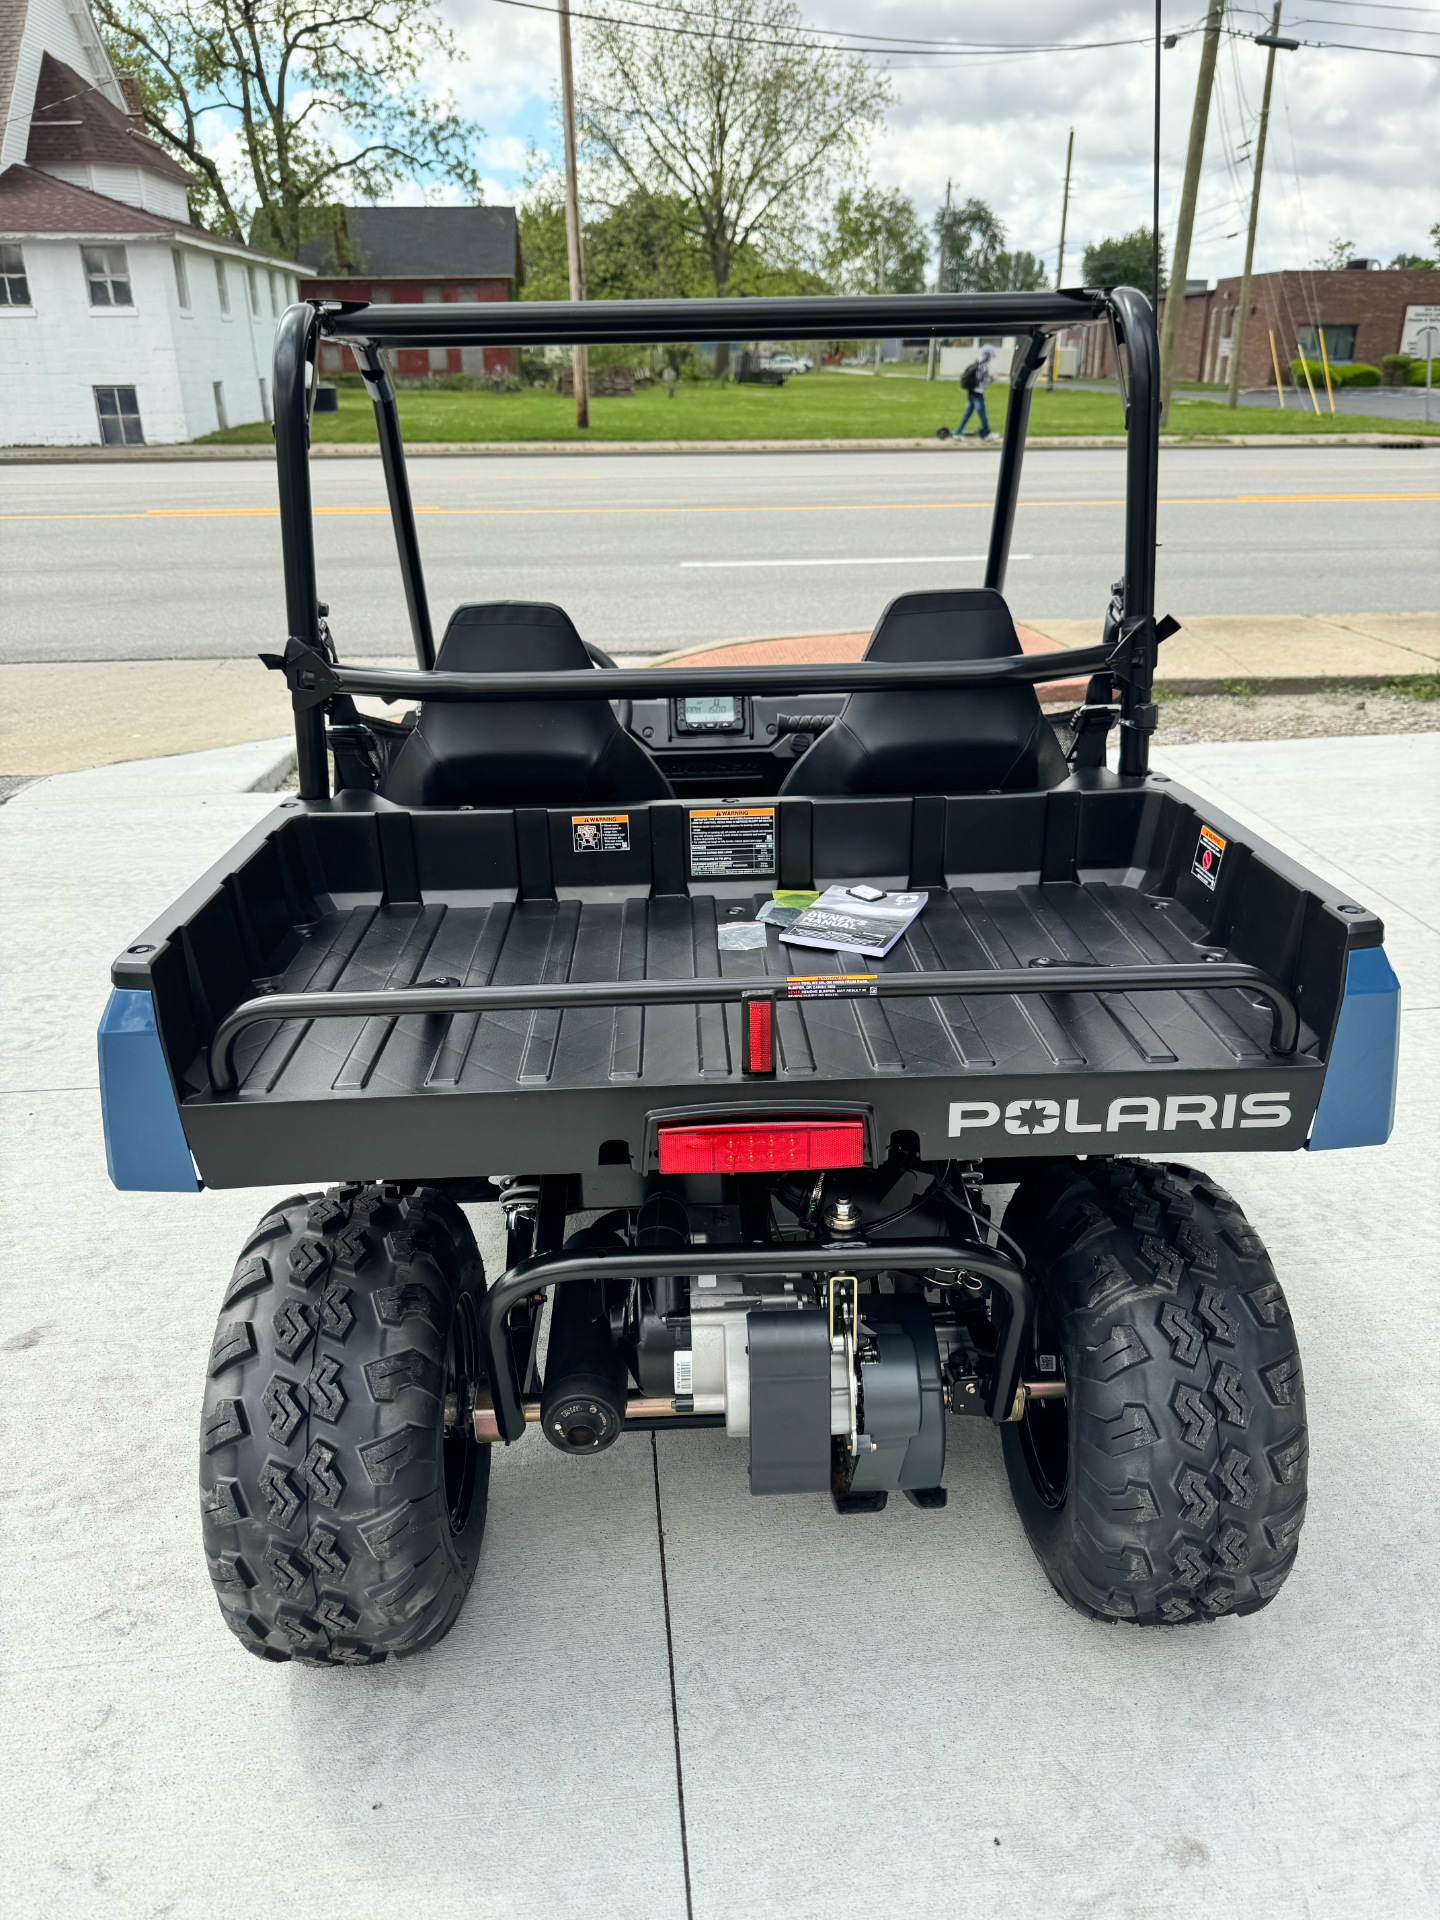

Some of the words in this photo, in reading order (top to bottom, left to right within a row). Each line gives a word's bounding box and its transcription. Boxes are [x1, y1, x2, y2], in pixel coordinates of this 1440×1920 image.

[687, 706, 702, 714] RPM
[708, 705, 727, 713] 1500
[801, 917, 857, 930] MANUAL
[808, 912, 868, 926] OWNER'S
[947, 1091, 1292, 1138] POLARIS
